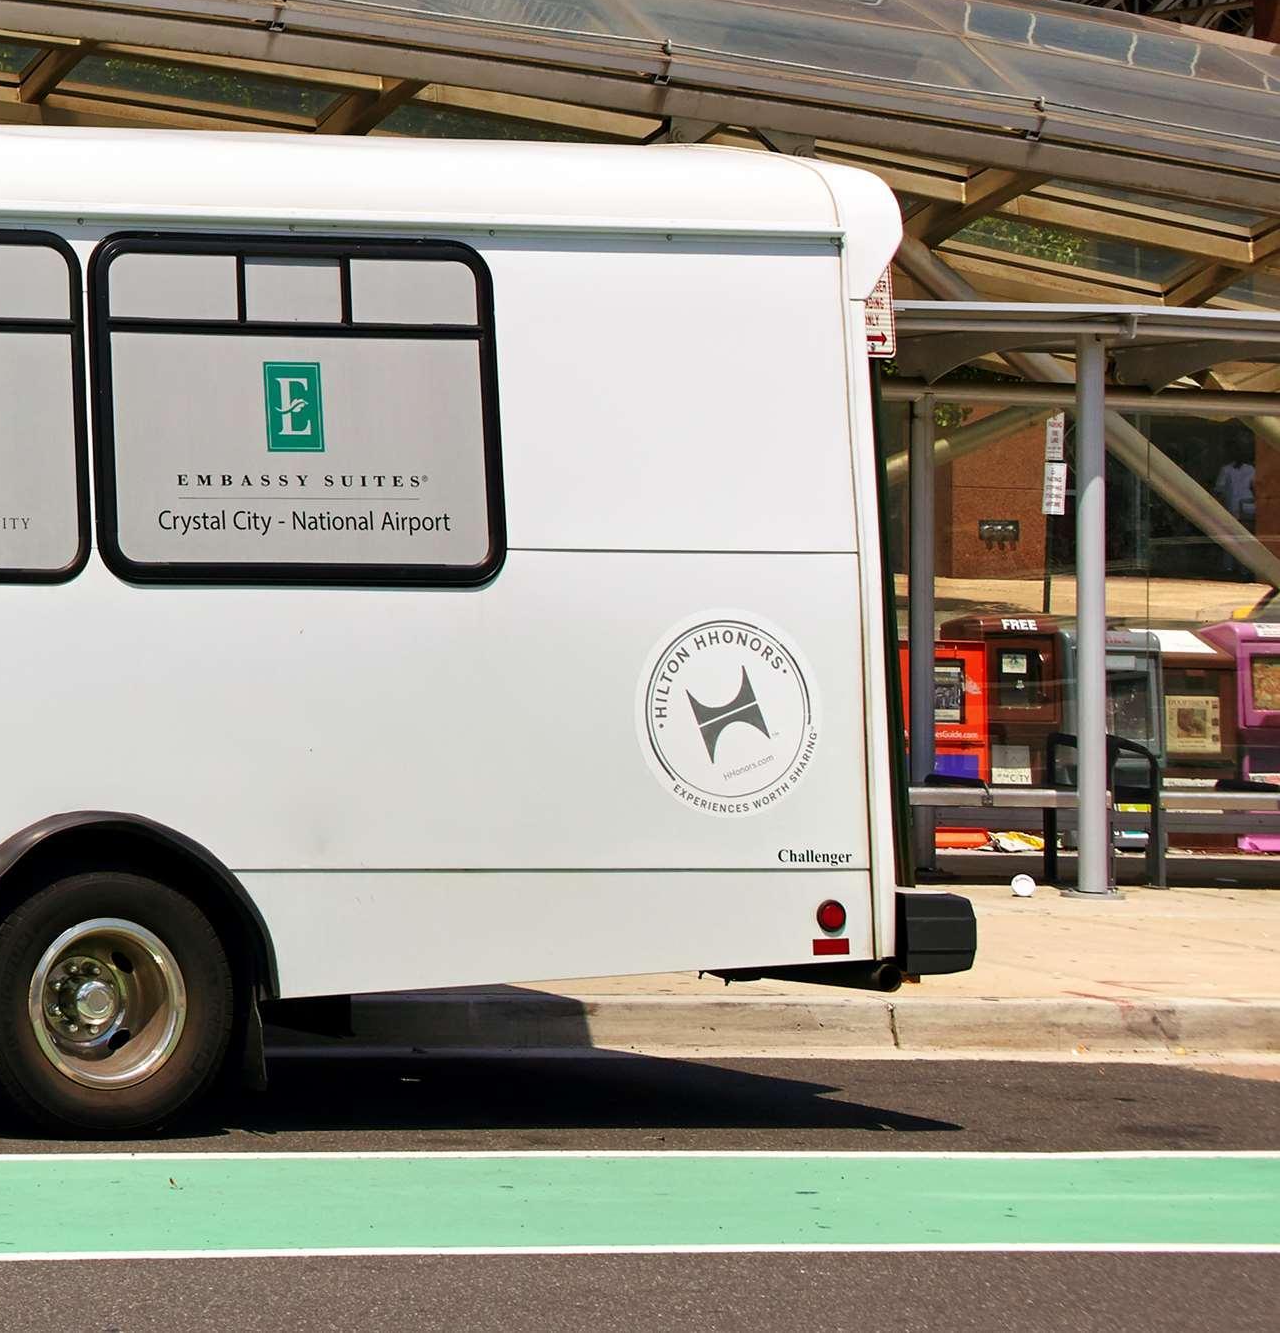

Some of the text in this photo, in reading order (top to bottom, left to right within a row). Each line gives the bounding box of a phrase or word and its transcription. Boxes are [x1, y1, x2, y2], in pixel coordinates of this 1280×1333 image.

[177, 474, 309, 488] EMBASSY
[158, 510, 226, 536] Crystal
[233, 510, 272, 536] City
[292, 510, 374, 532] National
[381, 510, 452, 536] Airport
[1001, 618, 1038, 631] FREE
[655, 629, 784, 719] HILTON HHONORS
[723, 754, 775, 781] HHonors.com
[673, 783, 750, 813] EXPERIENCES
[753, 782, 790, 809] WORTH
[777, 848, 853, 866] Challenger
